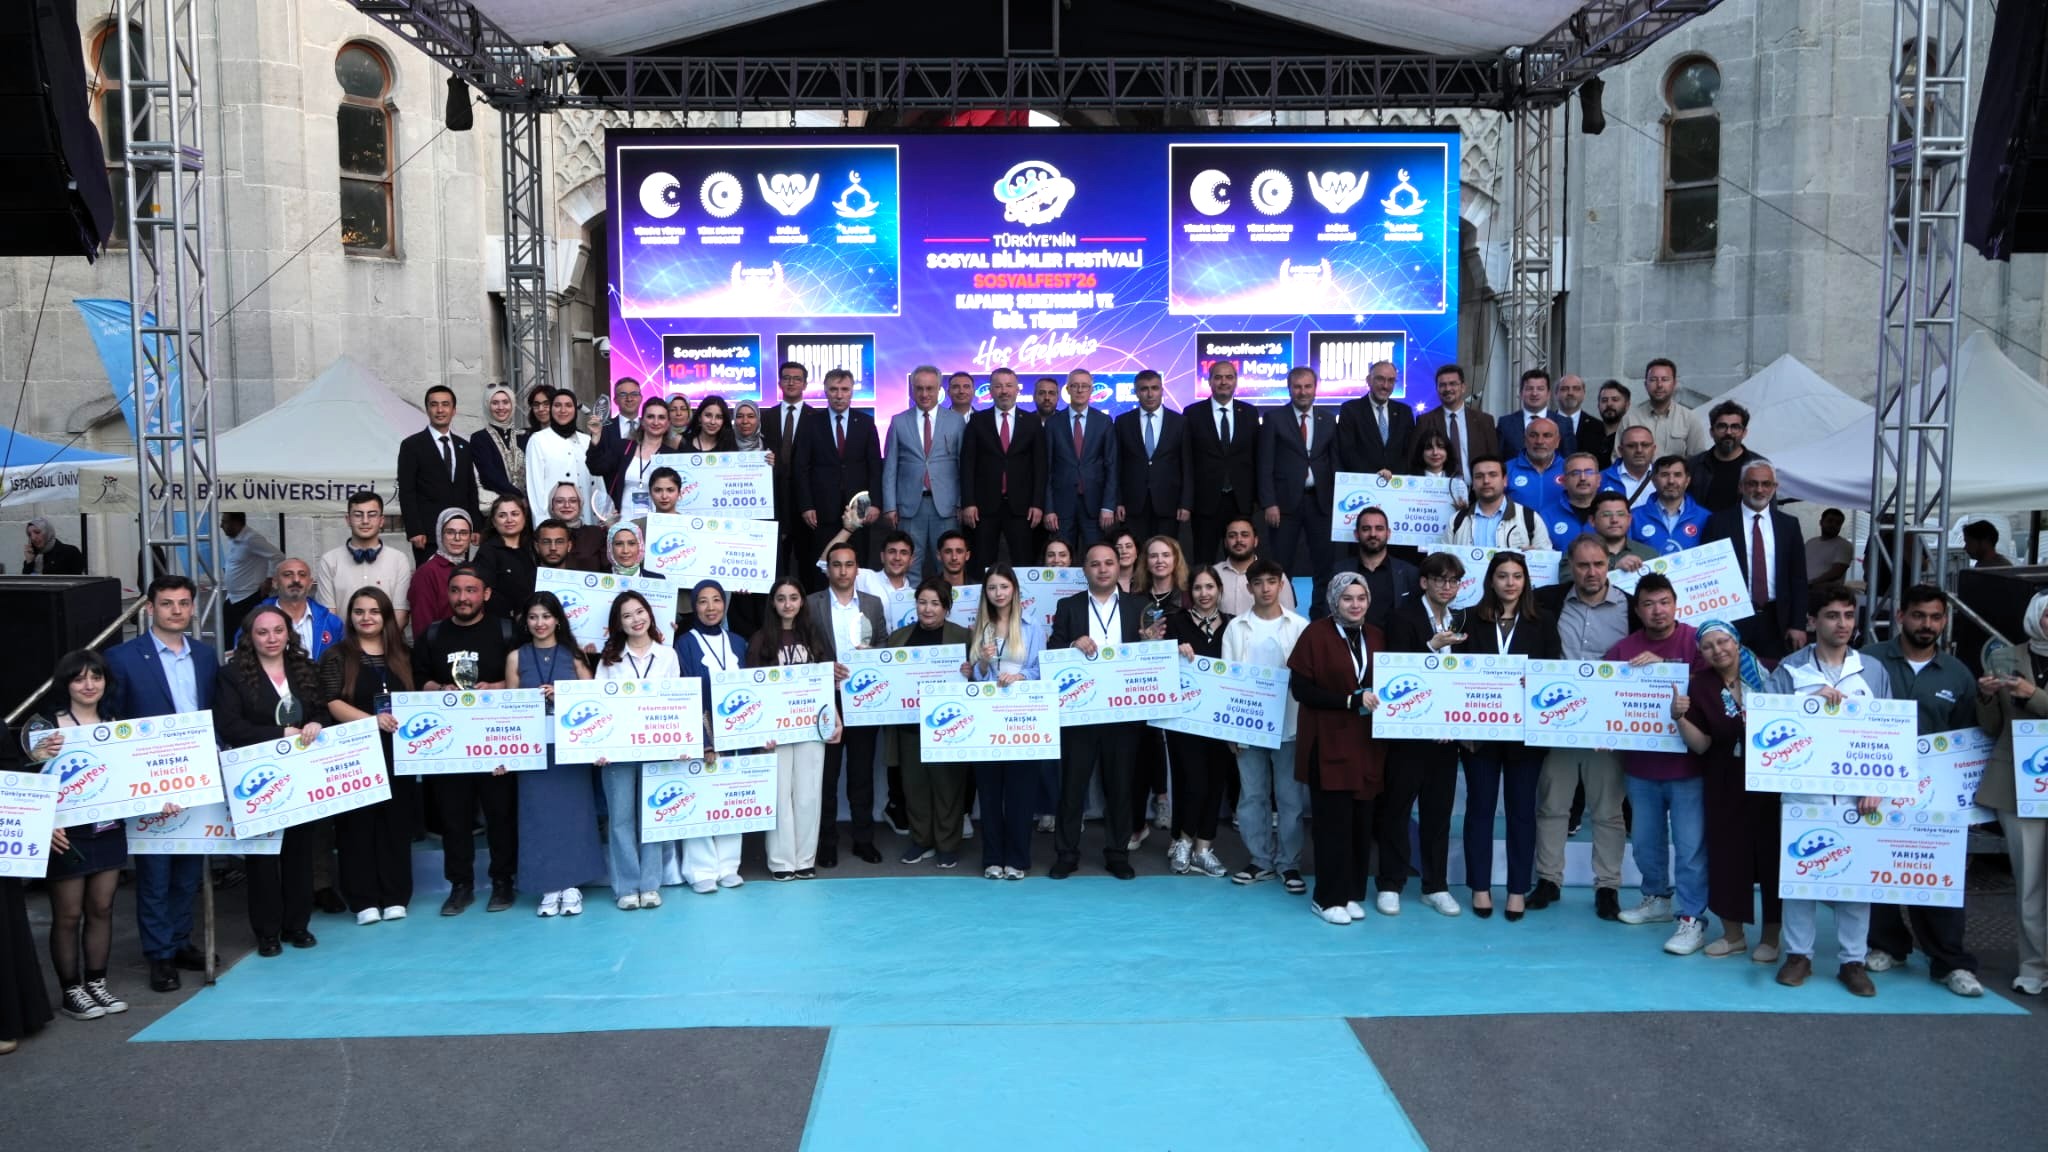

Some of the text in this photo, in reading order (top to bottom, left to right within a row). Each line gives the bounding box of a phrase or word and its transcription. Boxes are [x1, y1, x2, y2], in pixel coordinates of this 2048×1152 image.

[993, 232, 1076, 248] TÜRKİYE'NİN
[926, 252, 990, 269] SOSYAL
[1065, 248, 1143, 268] FESTİVALİ
[973, 272, 1097, 289] SOSYALFEST'26
[972, 332, 1099, 369] Hoş Geldiniz
[668, 363, 757, 381] 10-11 Mayıs
[1243, 360, 1288, 378] Mayıs
[10, 476, 55, 491] İSTANBUL
[712, 497, 757, 508] 30.000
[1393, 521, 1440, 533] 30.000
[709, 565, 758, 578] 30.000
[1676, 595, 1728, 618] 70.000
[1125, 677, 1158, 685] YARIŞMA
[1107, 692, 1166, 708] 100.000
[1230, 697, 1262, 708] YARIŞMA
[1466, 692, 1502, 700] YARIŞMA
[1622, 701, 1661, 710] YARIŞMA
[776, 714, 818, 729] 70.000
[1212, 711, 1264, 731] 30.000
[1444, 710, 1509, 724] 100.000
[1606, 719, 1664, 734] 10.000
[630, 731, 682, 745] 15.000
[989, 733, 1040, 745] 70.000
[465, 743, 530, 757] 100.000
[1849, 741, 1890, 752] YARIŞMA
[146, 755, 189, 768] YARIŞMA
[1846, 750, 1894, 761] ÜÇÜNCÜSÜ
[325, 759, 360, 773] YARIŞMA
[1830, 761, 1895, 778] 30.000
[129, 775, 196, 797] 70.000
[307, 775, 372, 803] 100.000
[724, 789, 756, 799] YARIŞMA
[706, 805, 762, 821] 100.000
[1891, 850, 1935, 862] YARIŞMA
[1893, 860, 1932, 871] İKİNCİSİ
[1869, 870, 1938, 886] 70.000
